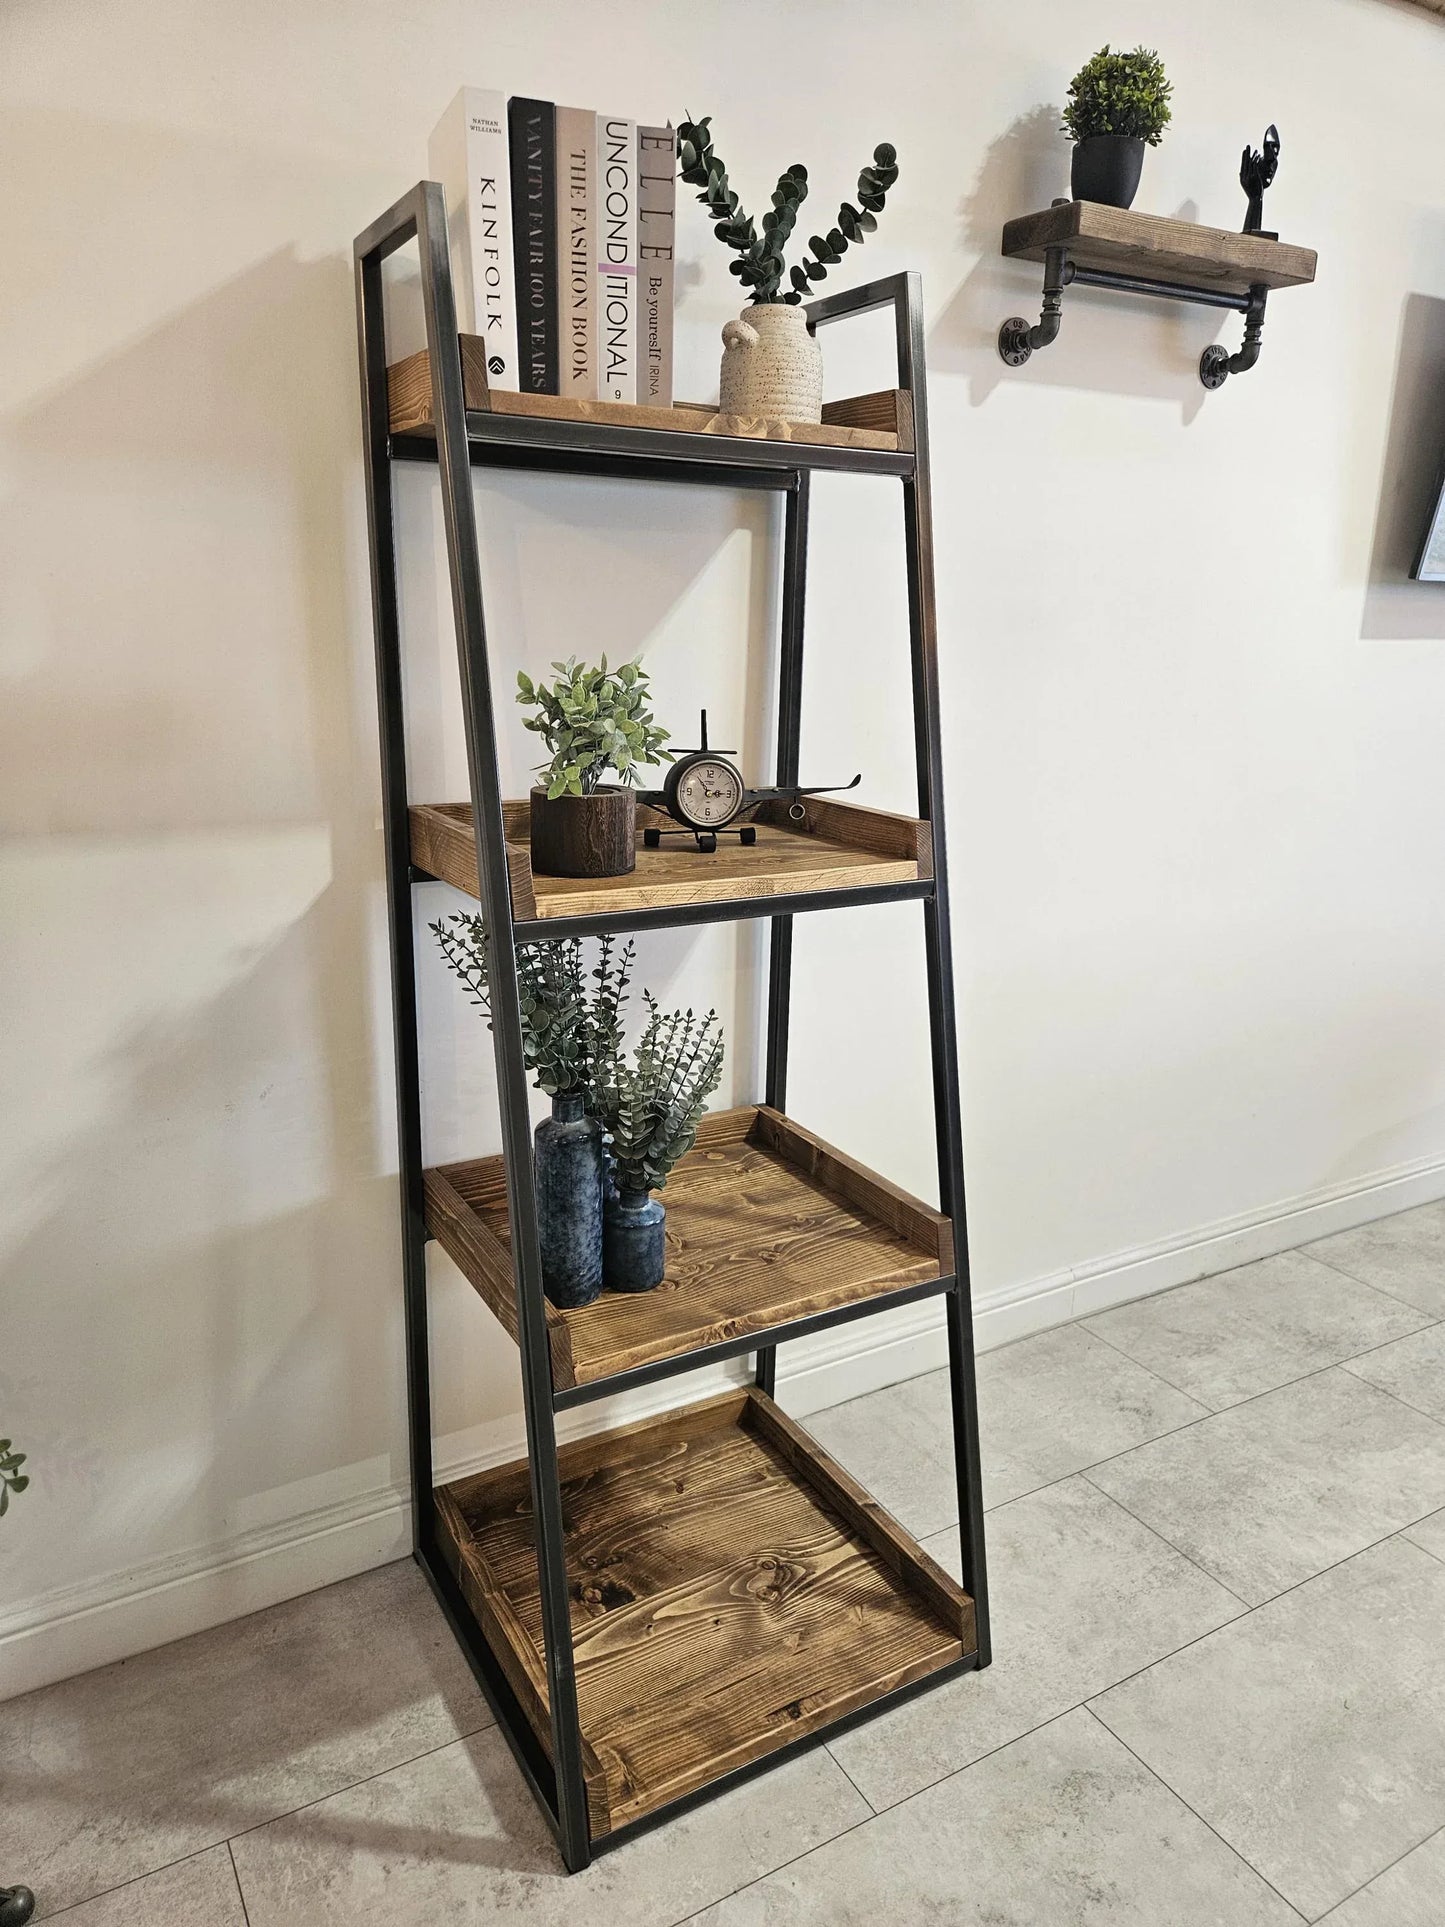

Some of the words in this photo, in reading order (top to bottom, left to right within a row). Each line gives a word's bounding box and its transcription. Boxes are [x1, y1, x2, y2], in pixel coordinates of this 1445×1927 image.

[470, 125, 501, 134] WILLIAMS
[472, 118, 499, 126] NATHAN
[525, 116, 544, 203] VANITY
[570, 149, 586, 199] THE
[640, 132, 674, 260] ELLE
[480, 178, 502, 330] KINFOLK
[528, 211, 544, 264] FAIR
[571, 207, 587, 309] FASHION
[529, 272, 545, 309] 100
[649, 277, 662, 296] Be
[531, 319, 547, 388] YEARS
[572, 317, 588, 380] BOOK
[649, 365, 659, 396] IRINA
[686, 787, 692, 796] 9
[706, 770, 714, 778] 12
[705, 808, 711, 816] 6
[726, 790, 732, 798] 3
